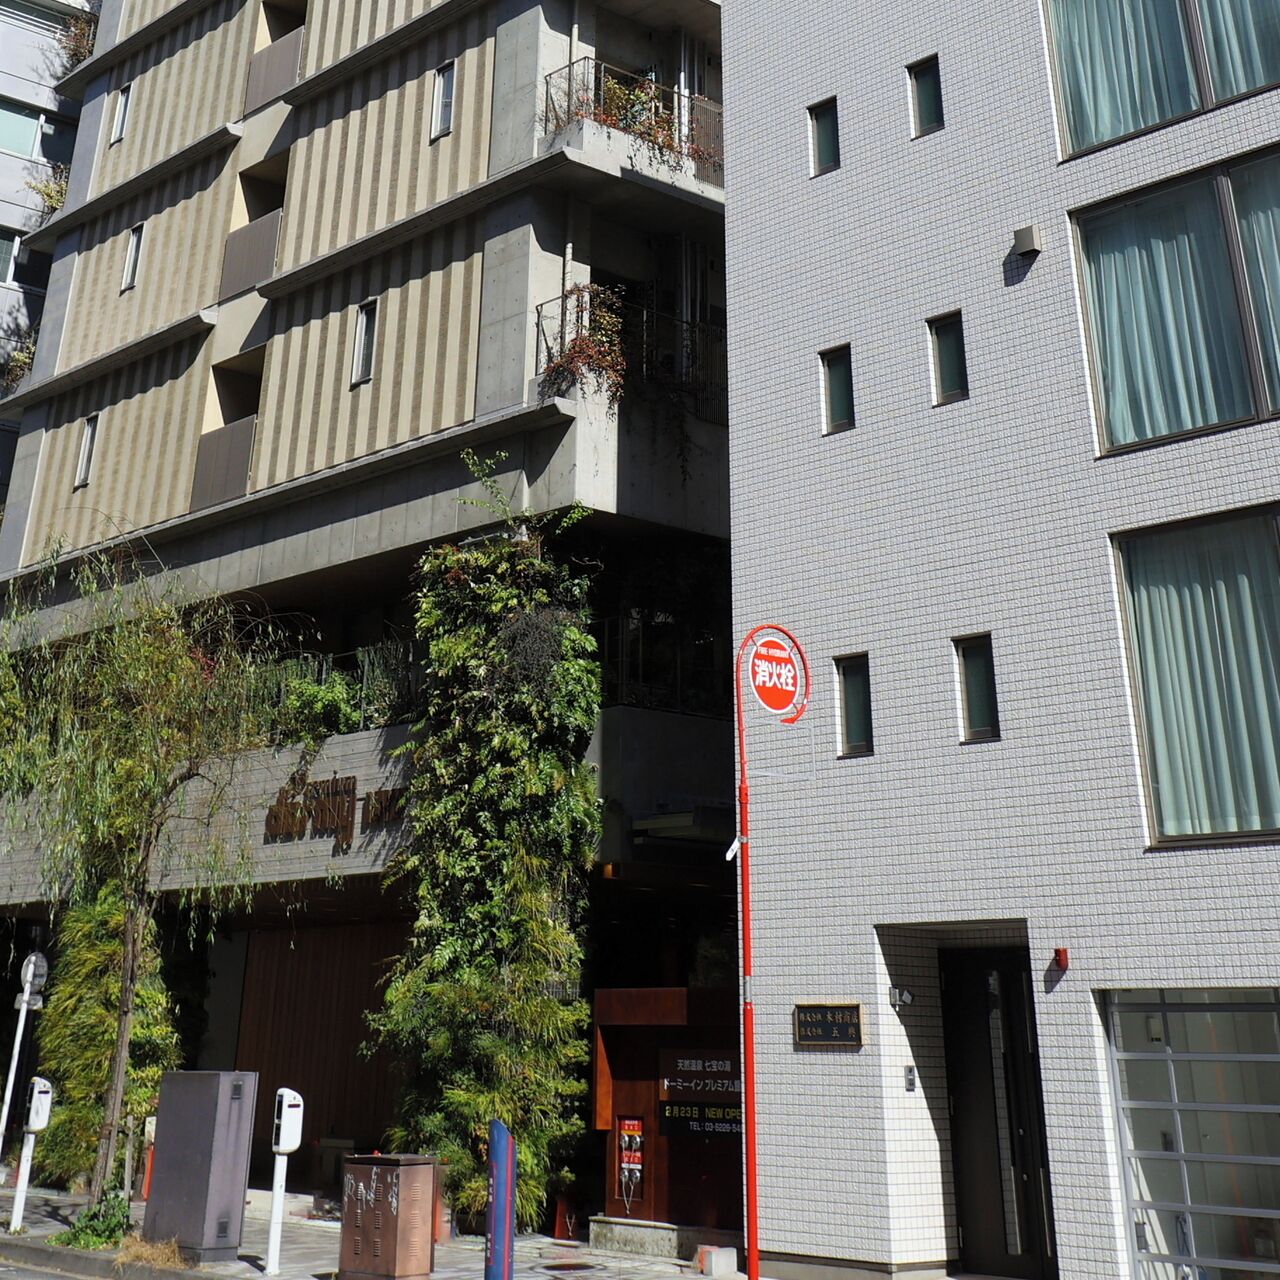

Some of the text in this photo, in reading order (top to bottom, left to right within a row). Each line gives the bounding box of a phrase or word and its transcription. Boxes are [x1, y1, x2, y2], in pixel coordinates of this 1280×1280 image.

[754, 658, 796, 691] 消火栓
[664, 1078, 704, 1091] ドーミーイン
[665, 1106, 699, 1118] 2月23日
[705, 1107, 724, 1119] NEW
